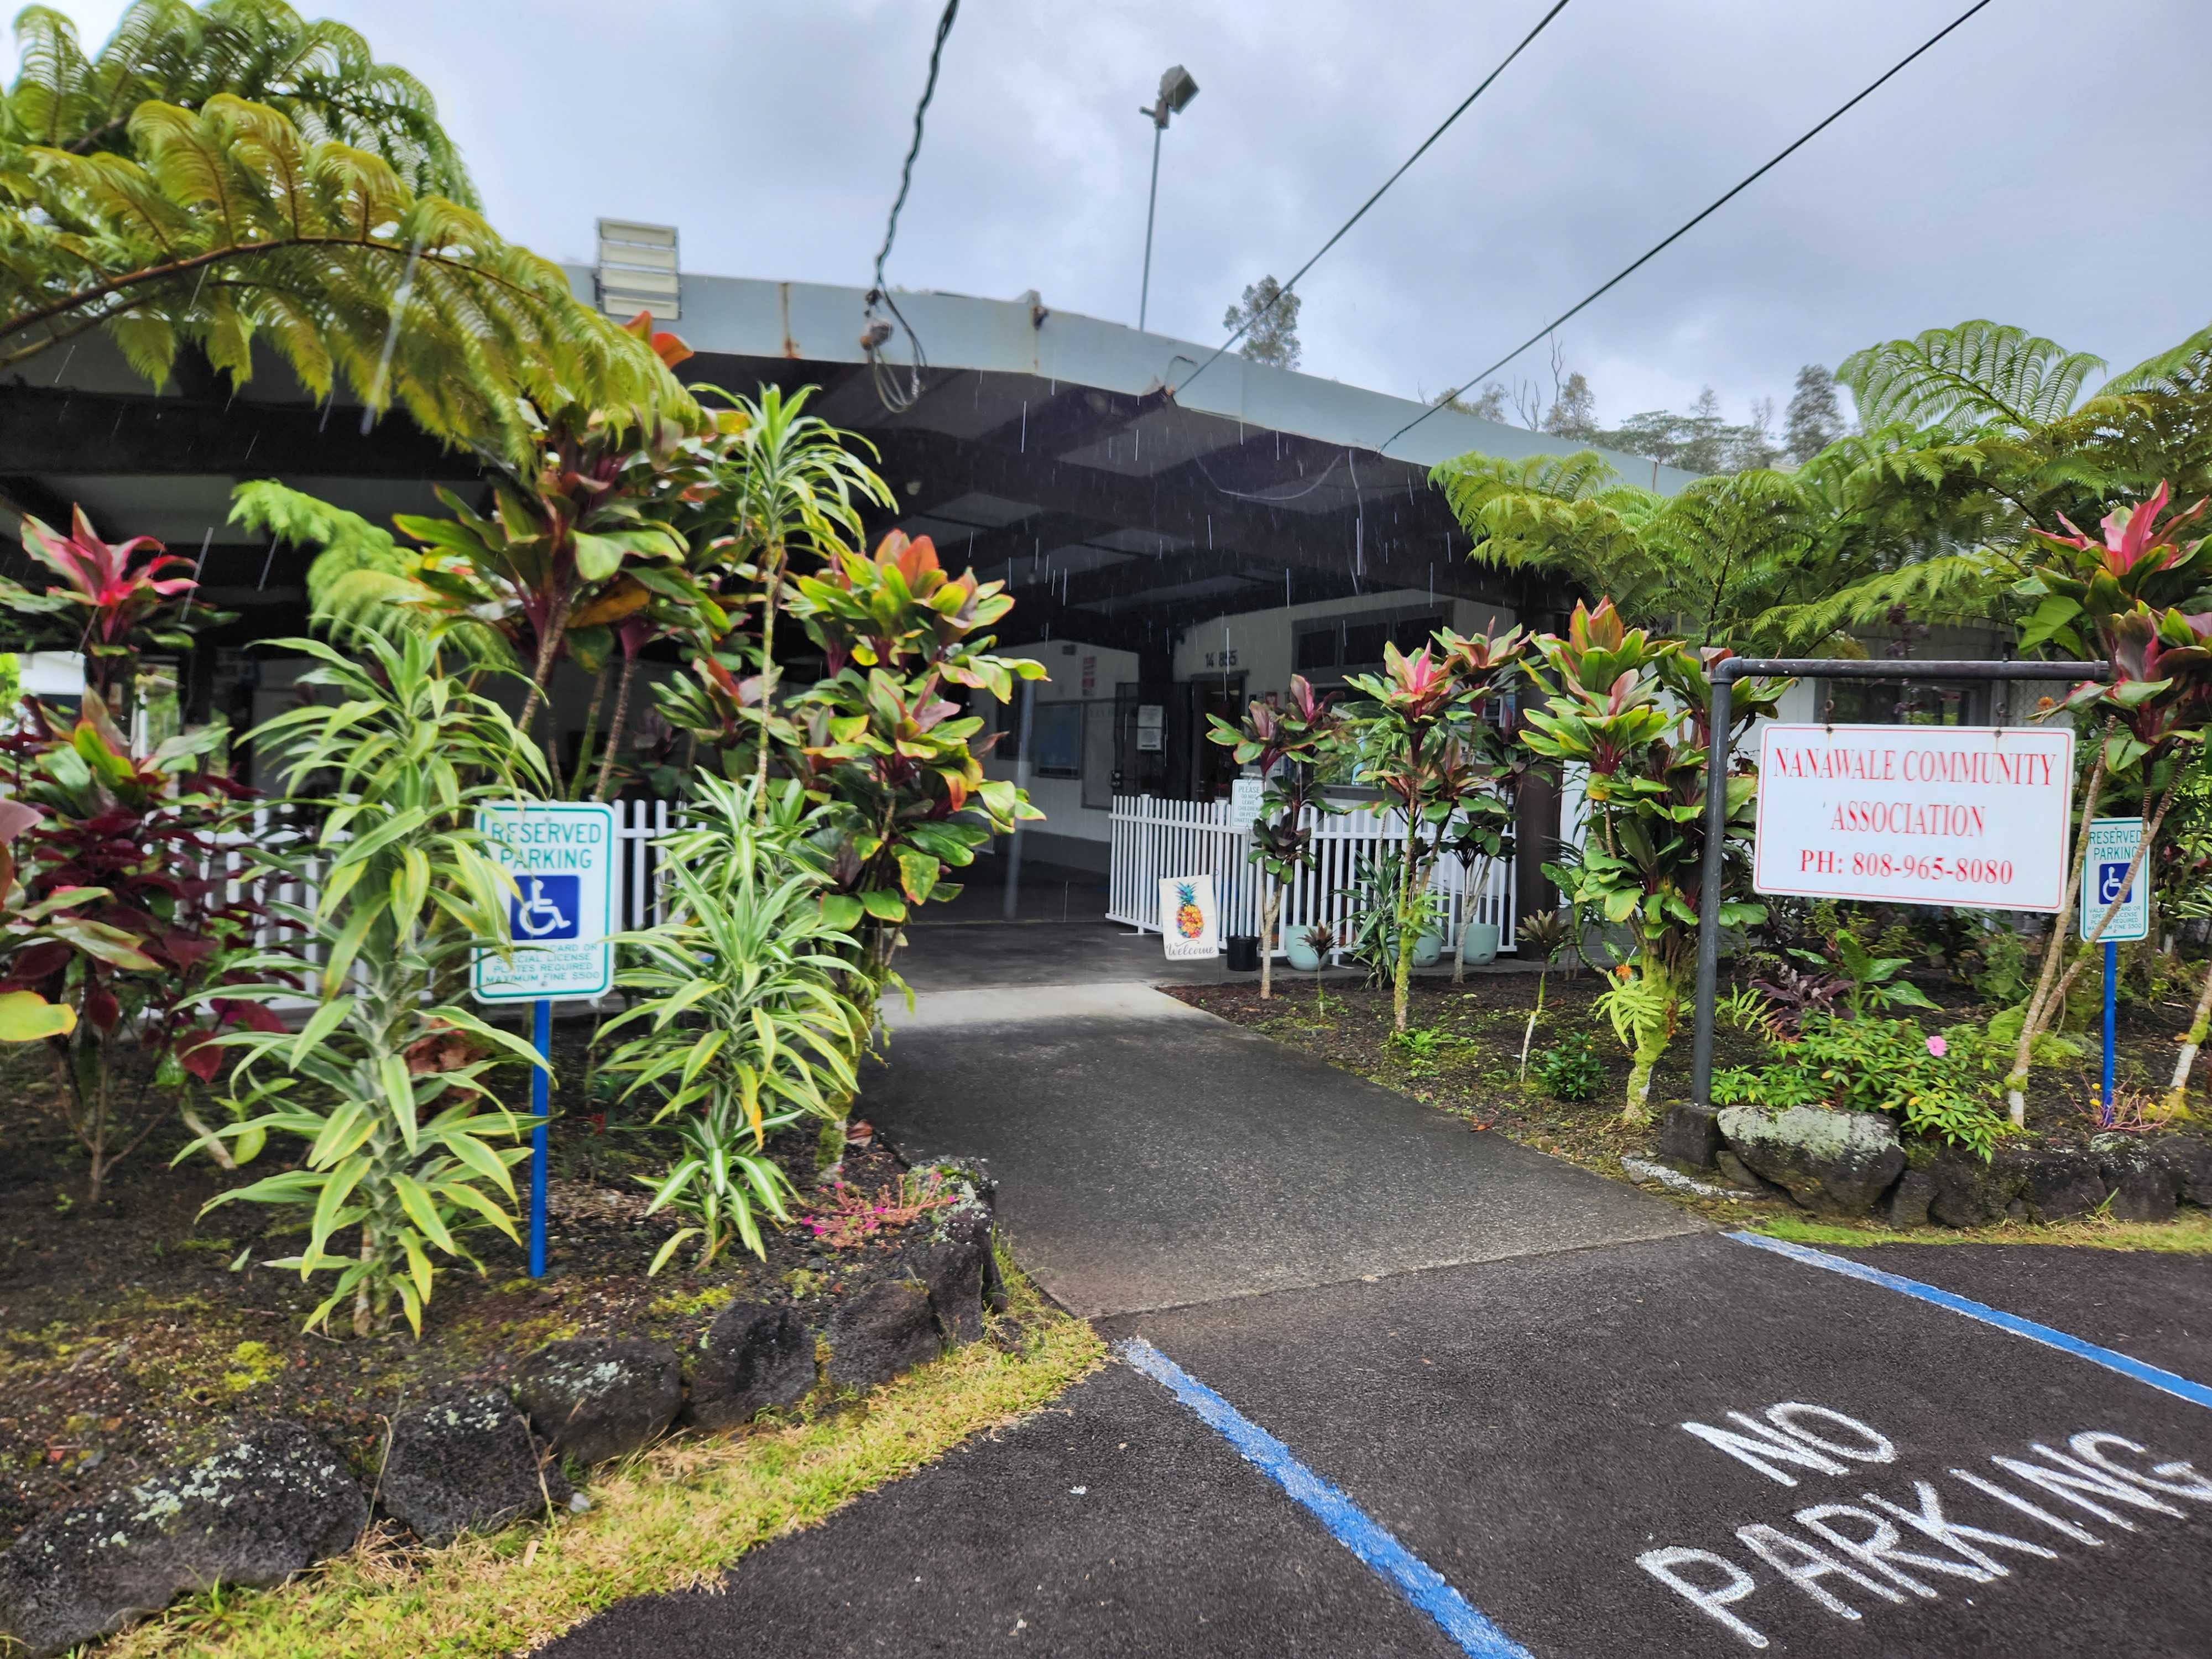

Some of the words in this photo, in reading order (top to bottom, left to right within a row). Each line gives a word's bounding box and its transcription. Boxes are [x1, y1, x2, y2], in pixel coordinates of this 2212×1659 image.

[1773, 748, 1896, 780] NANAWALE
[1903, 750, 2057, 785] COMMUNITY
[1830, 800, 1986, 837] ASSOCIATION
[492, 822, 601, 844] RESERVED
[2089, 830, 2141, 844] RESERVED
[500, 848, 592, 869] PARKING
[1799, 849, 1843, 874] PH:
[1853, 852, 2013, 884] 808-965-8080
[583, 943, 597, 951] OR
[1166, 943, 1215, 956] Welcome
[493, 964, 535, 973] PLTES
[540, 962, 593, 971] REQUIRED
[495, 954, 541, 963] SECIAL
[547, 953, 591, 962] LICENSE
[486, 974, 539, 983] MAXIMUM
[544, 972, 567, 980] FINE
[572, 971, 600, 980] $500
[1680, 1401, 1896, 1486] NO
[1635, 1430, 2212, 1648] PARKING
